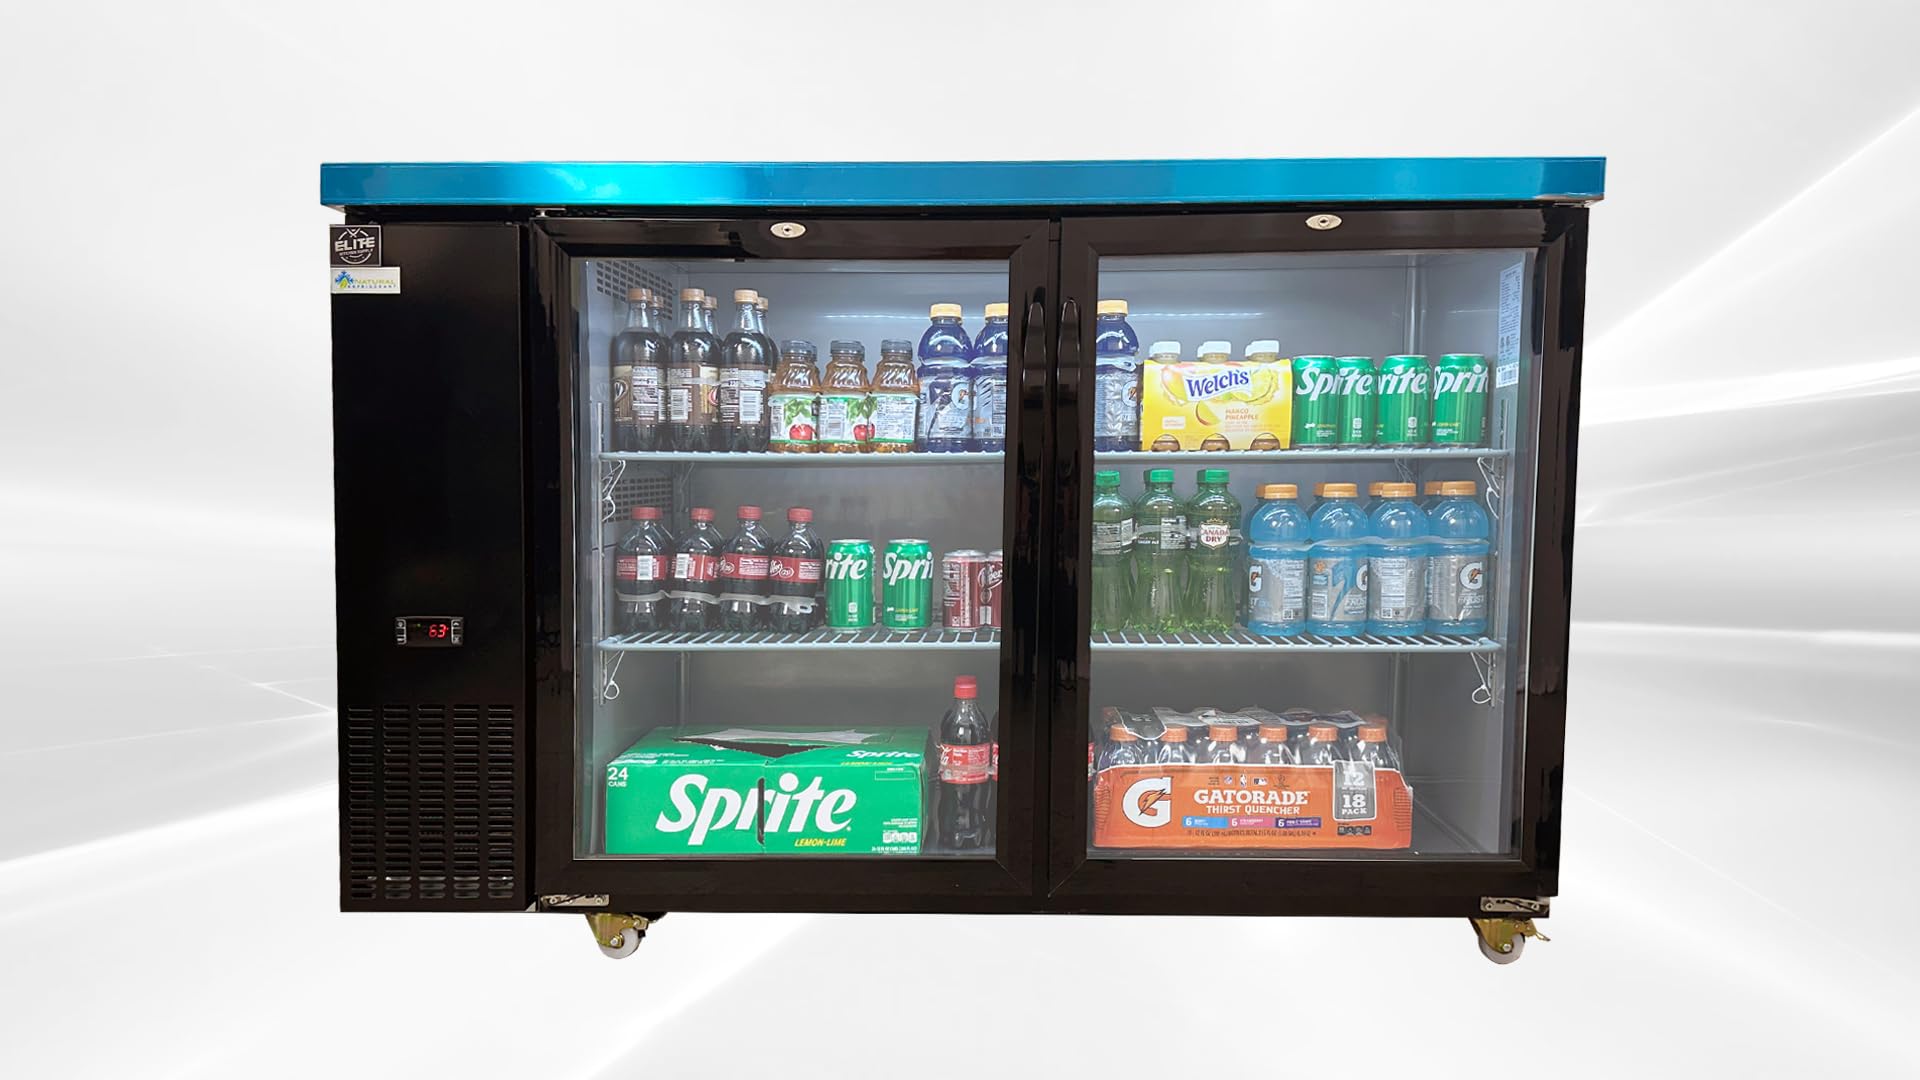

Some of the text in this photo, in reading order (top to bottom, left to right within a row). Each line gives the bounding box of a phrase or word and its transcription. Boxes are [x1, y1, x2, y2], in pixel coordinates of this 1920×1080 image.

[334, 236, 376, 252] ELITE
[1186, 370, 1249, 397] Welch's
[1205, 535, 1222, 543] DRY
[428, 623, 447, 638] 63
[608, 767, 628, 781] 24
[1342, 771, 1365, 786] 12
[1193, 789, 1311, 805] GATORADE
[1343, 794, 1366, 808] 18
[655, 773, 857, 846] Sprite
[1206, 805, 1300, 815] THIRST QUENCHER
[1185, 817, 1192, 826] 6
[1231, 818, 1238, 827] 6
[1277, 819, 1285, 828] 6
[794, 838, 847, 847] LEMON-LIME
